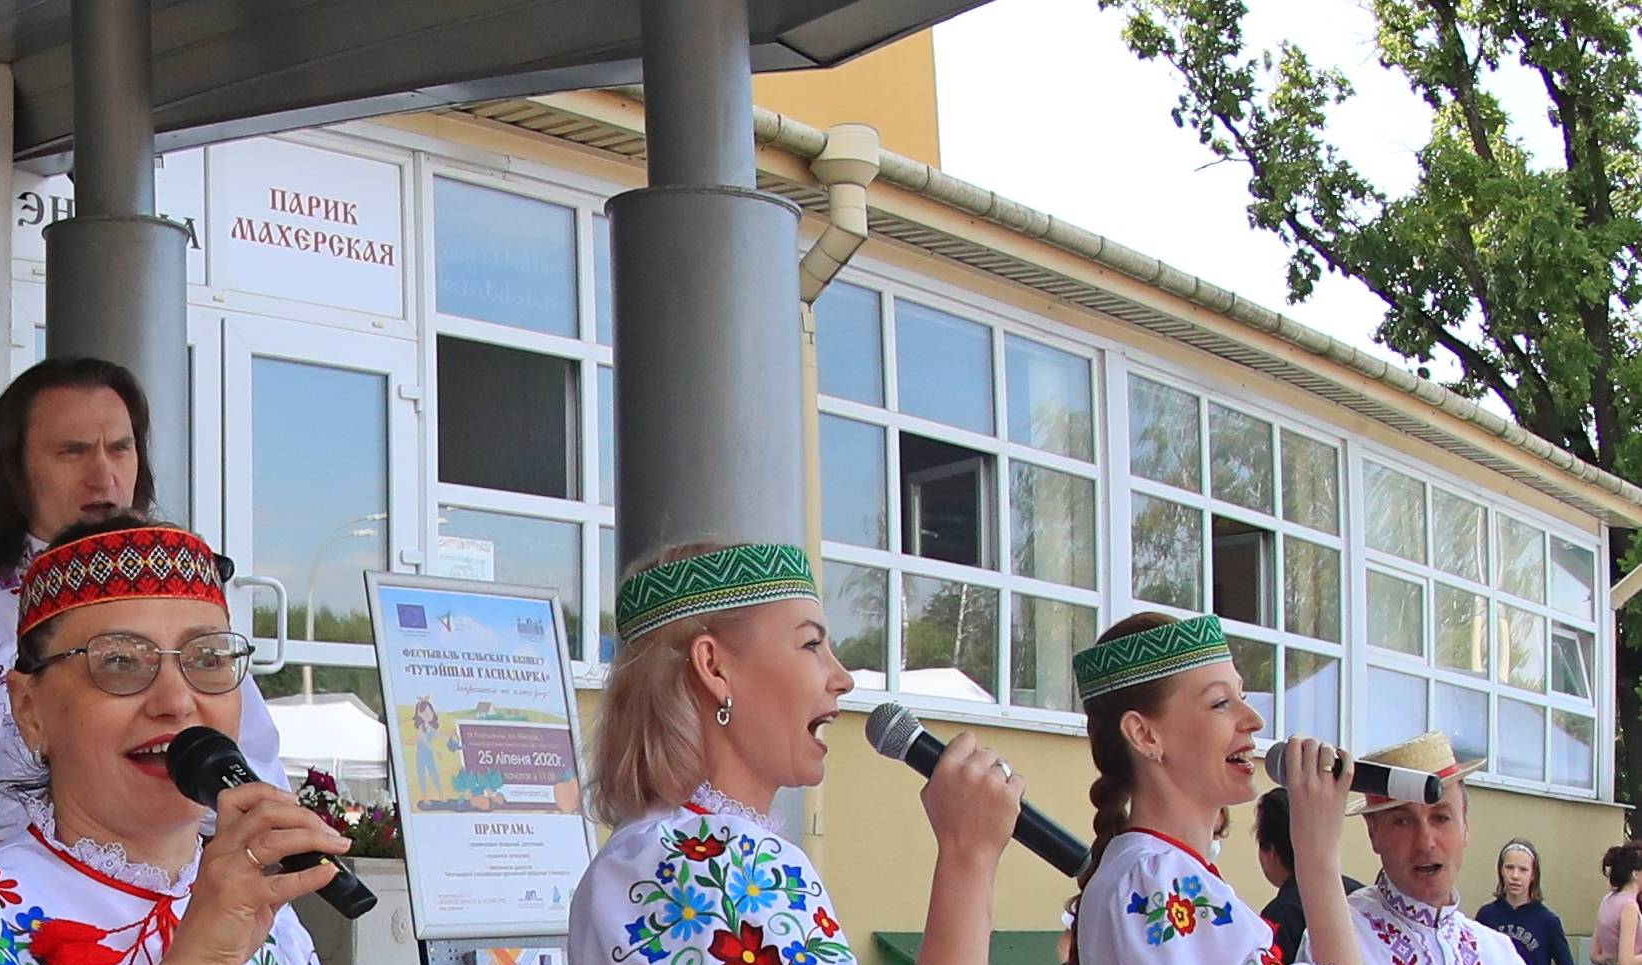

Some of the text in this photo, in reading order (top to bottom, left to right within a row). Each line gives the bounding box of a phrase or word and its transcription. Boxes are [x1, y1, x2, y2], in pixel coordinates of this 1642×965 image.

[268, 187, 359, 226] ПАРИК
[230, 215, 396, 267] МАХЕРСКАЯ
[402, 648, 459, 660] ФЕСТЫВАЛЬ
[462, 651, 509, 663] СЕЛЬСКАГА
[478, 750, 493, 765] 25
[474, 823, 535, 835] ПРАГРАМА:
